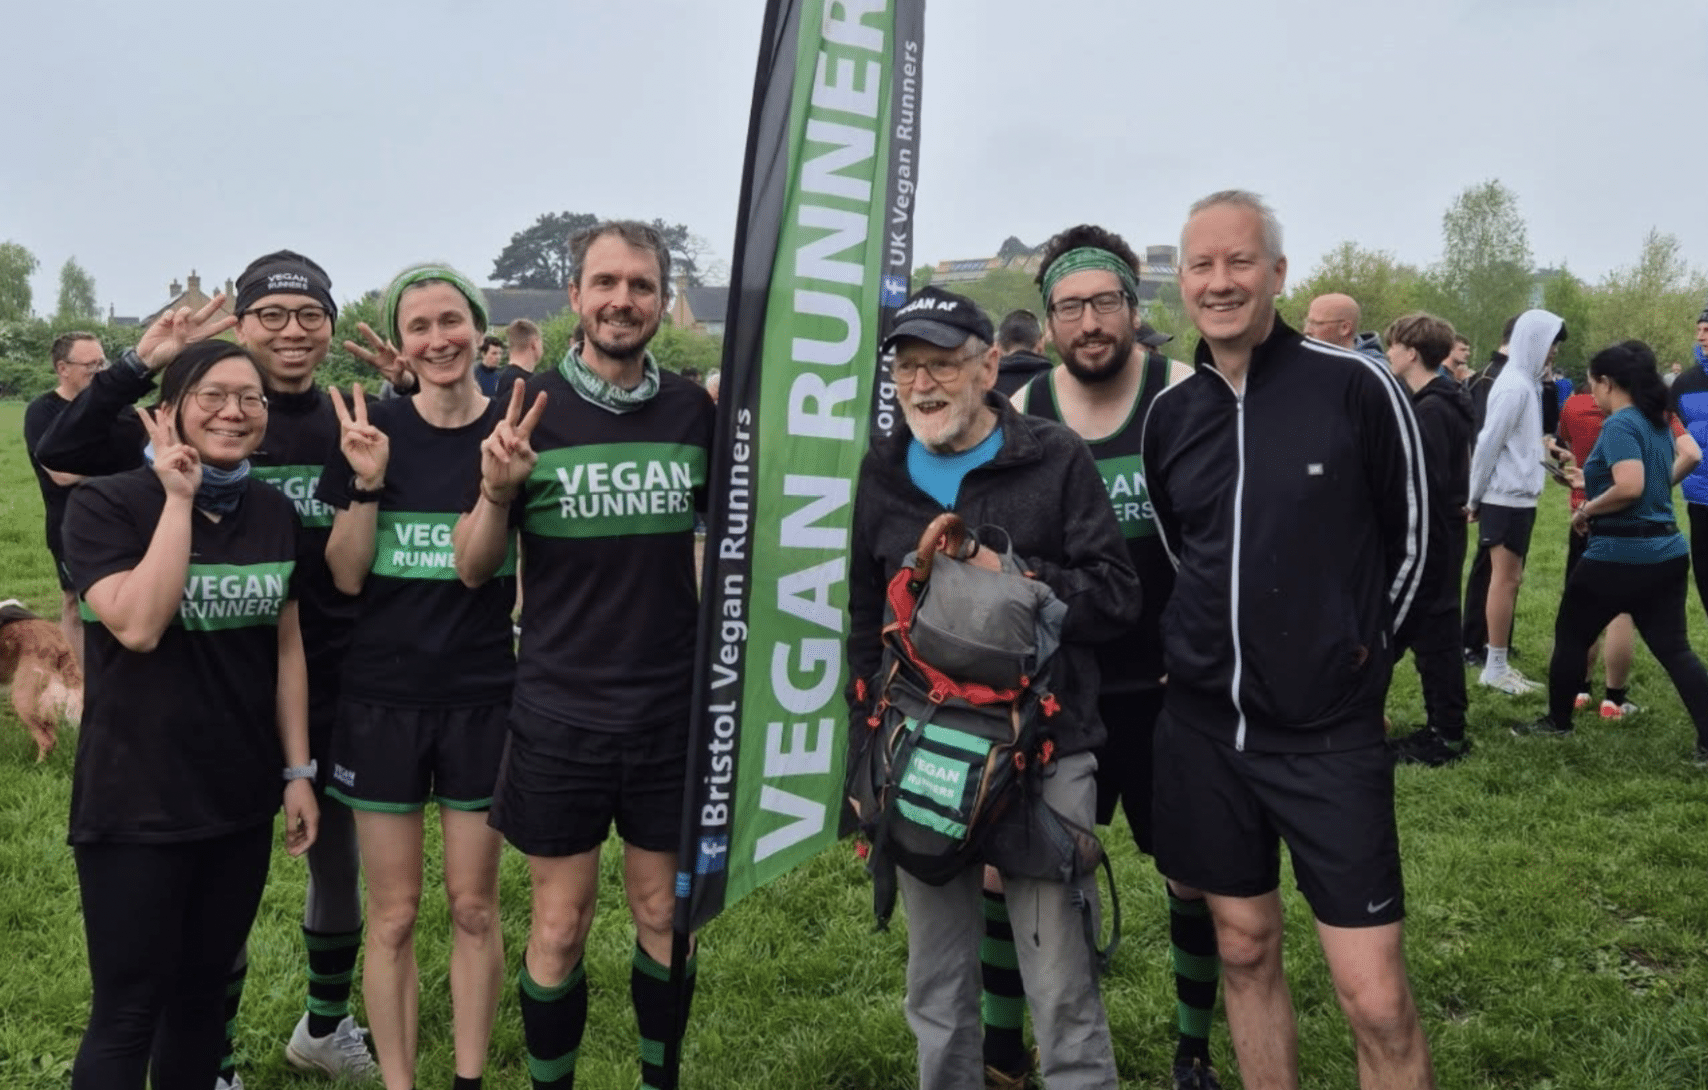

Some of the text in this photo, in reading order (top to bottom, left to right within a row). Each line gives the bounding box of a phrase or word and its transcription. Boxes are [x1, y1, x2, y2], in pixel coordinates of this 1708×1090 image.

[896, 40, 918, 141] Runners
[892, 148, 914, 224] Vegan
[890, 231, 907, 266] UK
[754, 0, 888, 864] VEGAN RUNNER
[556, 460, 692, 495] VEGAN
[559, 490, 691, 519] RUNNERS
[719, 407, 752, 559] Runners
[392, 550, 456, 568] RUNNE
[394, 523, 453, 547] VEG
[184, 574, 283, 600] VEGAN
[711, 574, 748, 690] Vegan
[701, 700, 737, 826] Bristol
